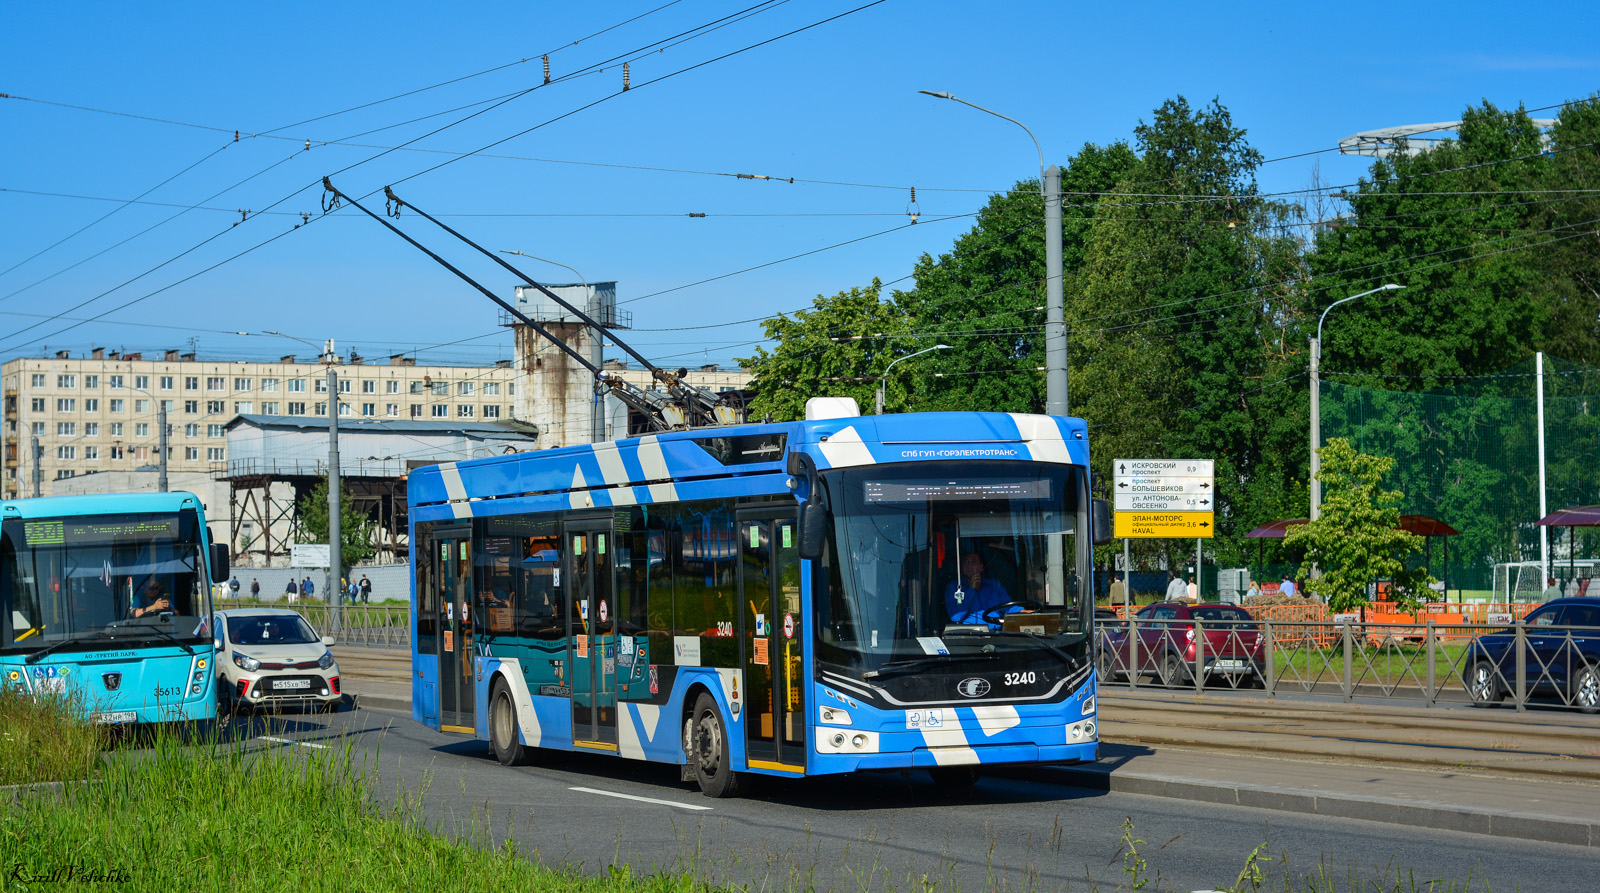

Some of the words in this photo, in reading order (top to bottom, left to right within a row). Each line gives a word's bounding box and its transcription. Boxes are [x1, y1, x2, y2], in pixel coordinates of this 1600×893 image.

[936, 449, 1018, 457] «ГОРЭЛЕКТРОТРАНС»
[717, 621, 733, 637] 3240
[1004, 671, 1036, 686] 3240
[153, 686, 181, 697] 35613
